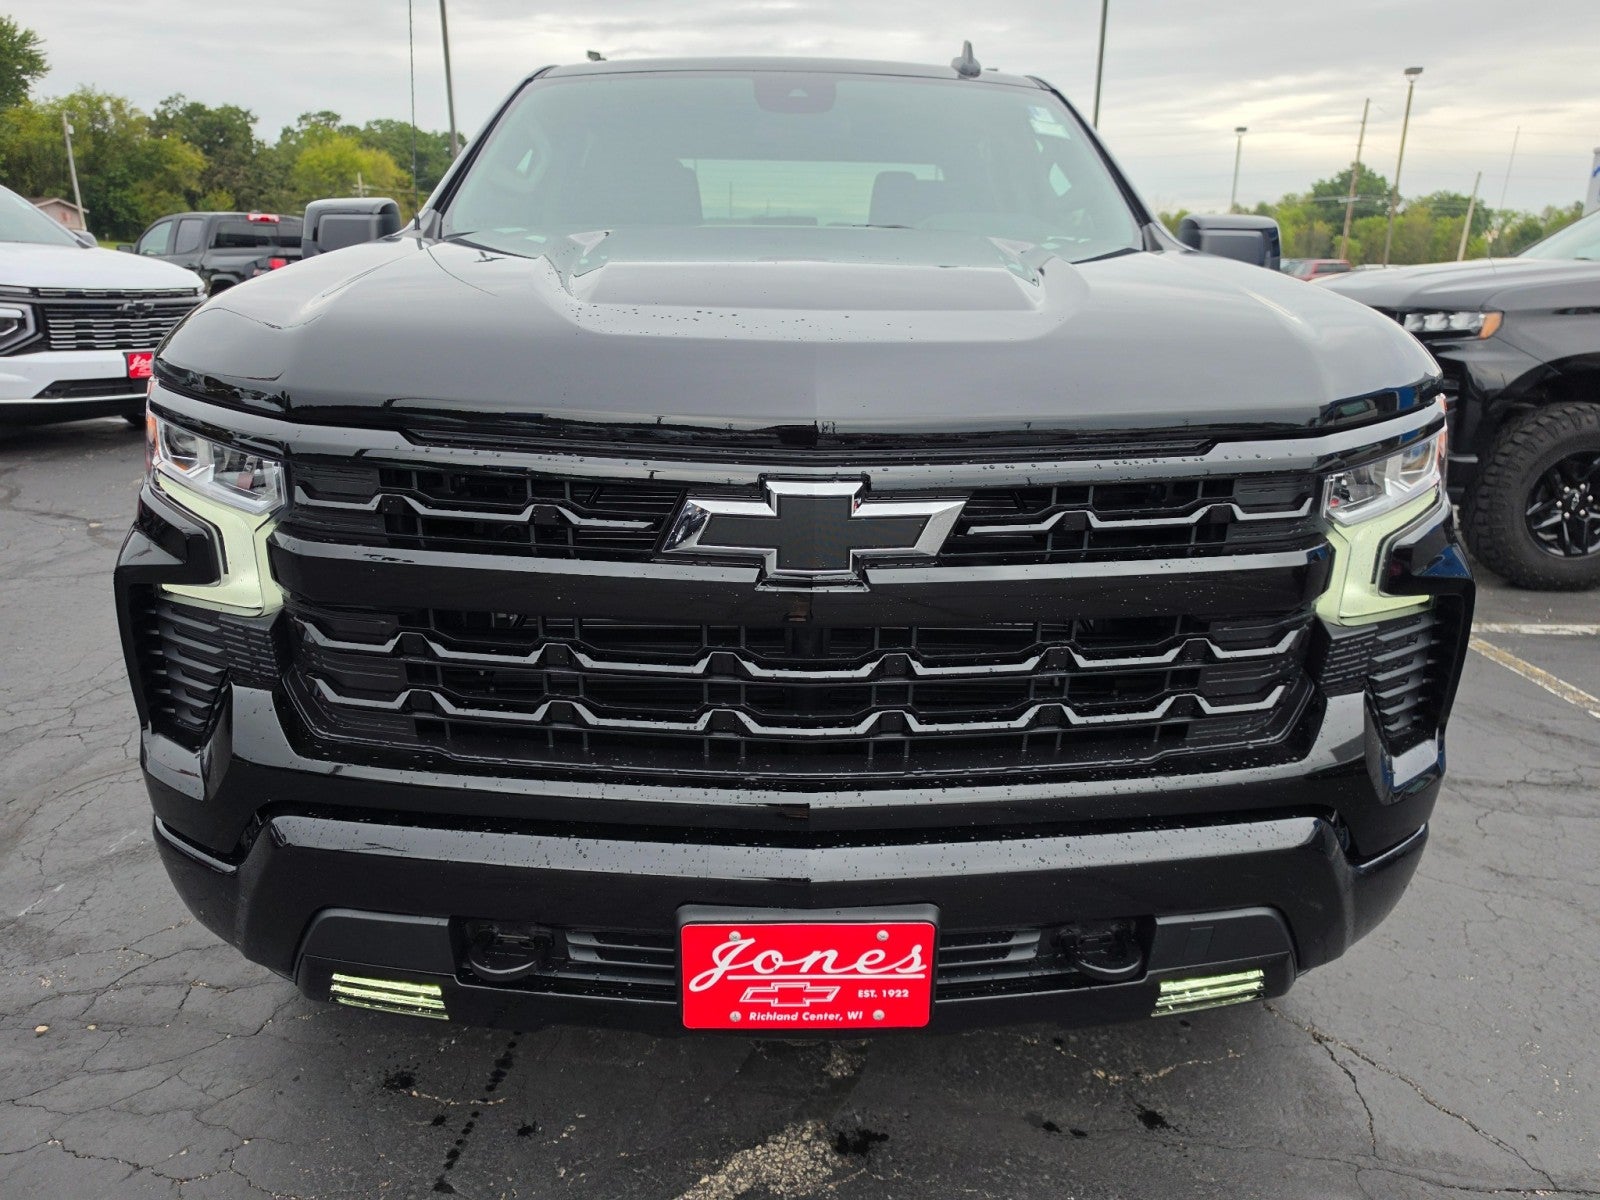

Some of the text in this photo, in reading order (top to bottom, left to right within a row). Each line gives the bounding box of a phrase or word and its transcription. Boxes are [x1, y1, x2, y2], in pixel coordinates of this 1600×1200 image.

[689, 938, 927, 993] Jones
[858, 989, 909, 998] EST. 1922
[749, 1011, 863, 1022] Richland Center, WI
